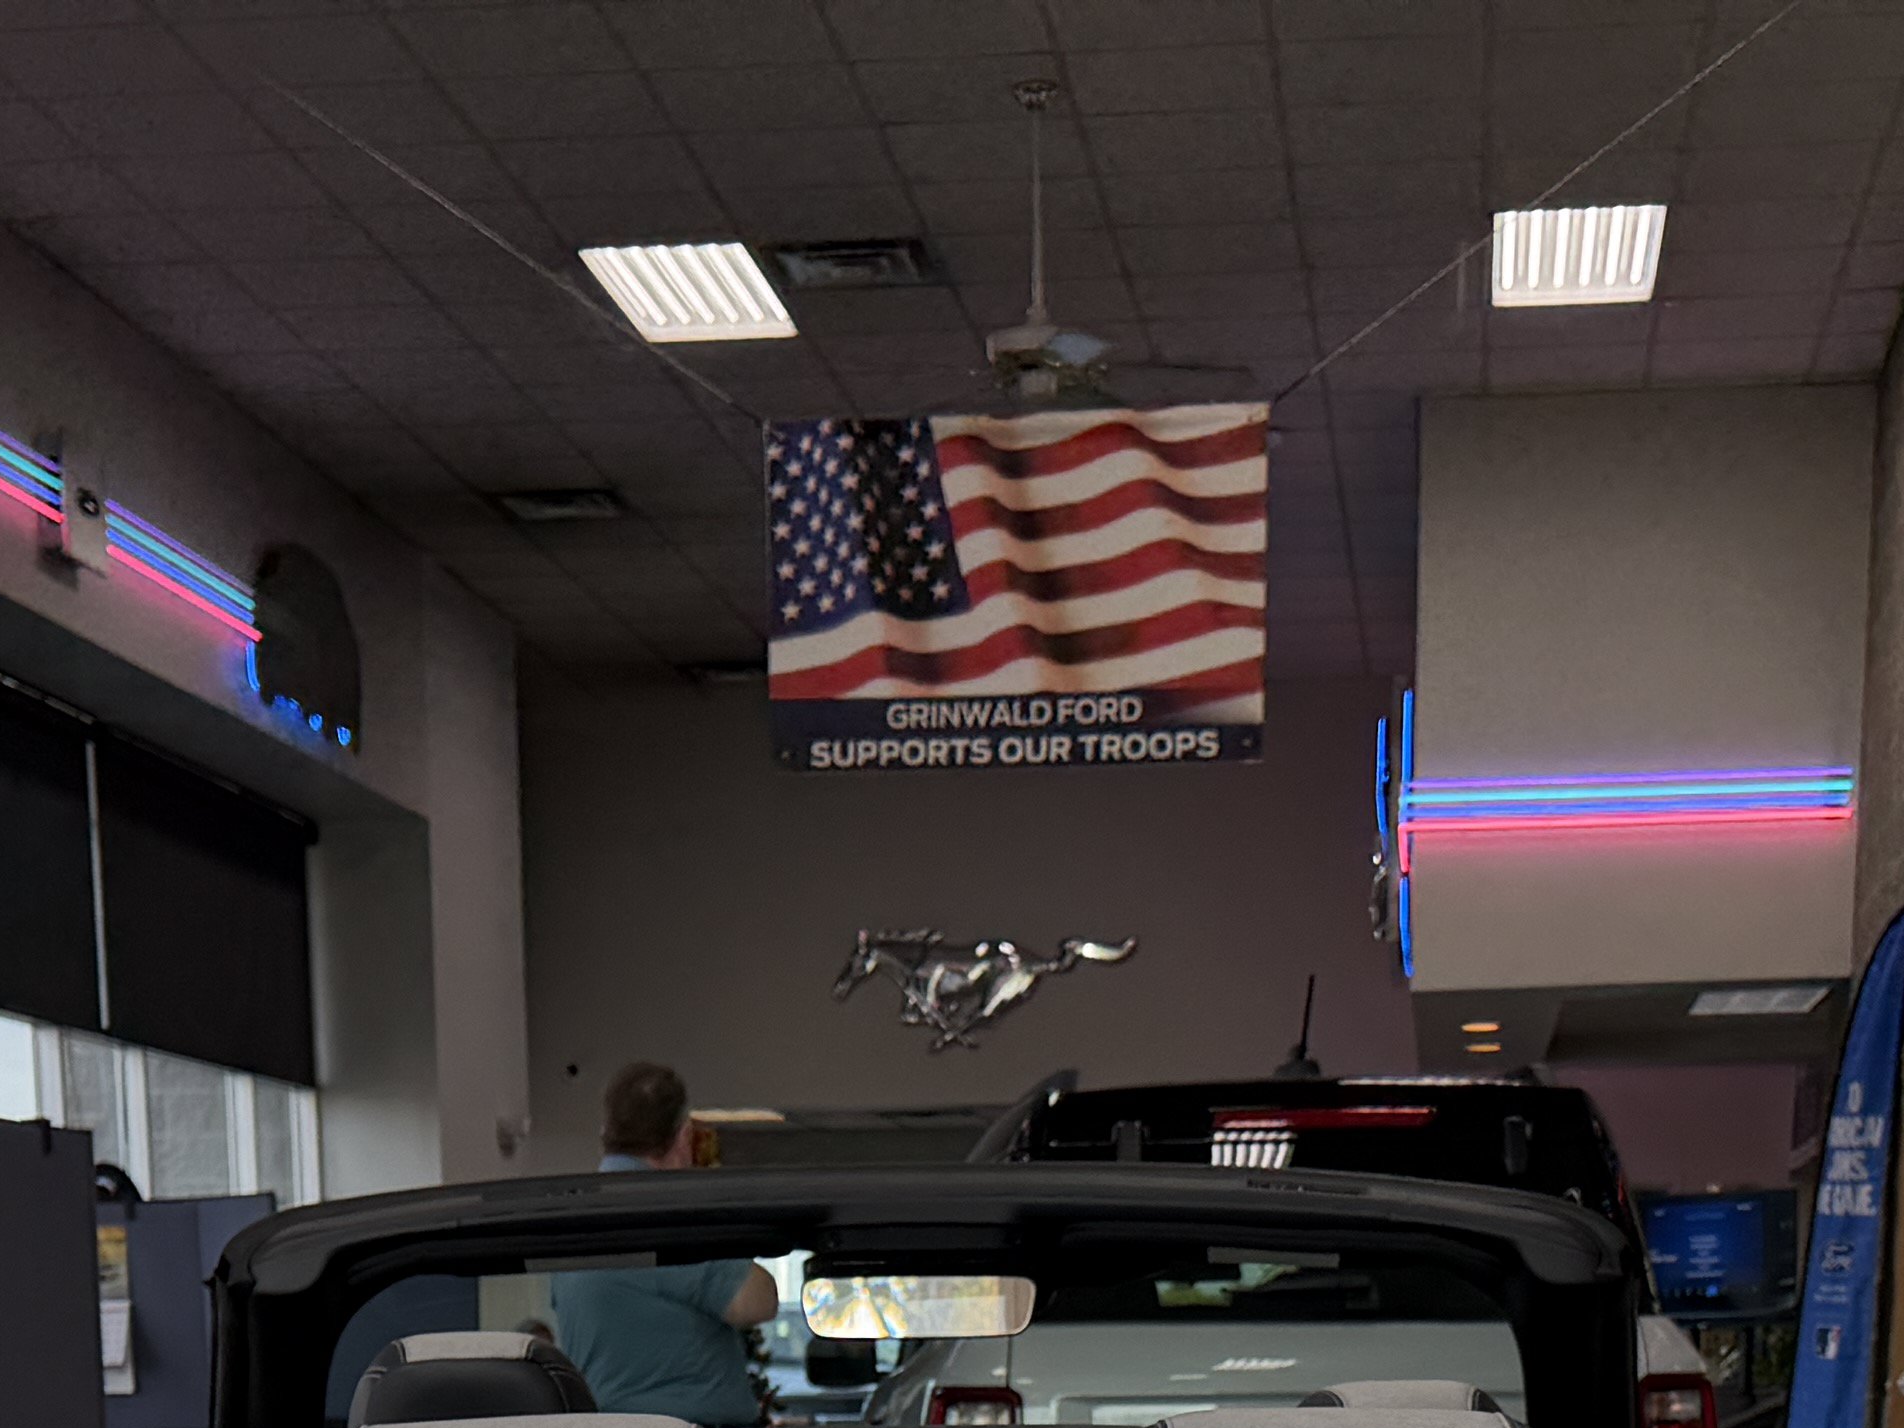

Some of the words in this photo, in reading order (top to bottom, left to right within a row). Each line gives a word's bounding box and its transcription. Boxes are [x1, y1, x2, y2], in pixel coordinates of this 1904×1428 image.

[886, 700, 1053, 730] GRINWALD
[1058, 697, 1143, 726] FORD
[809, 736, 993, 769] SUPPORTS
[998, 735, 1073, 765] OUR
[1077, 730, 1220, 762] TROOPS
